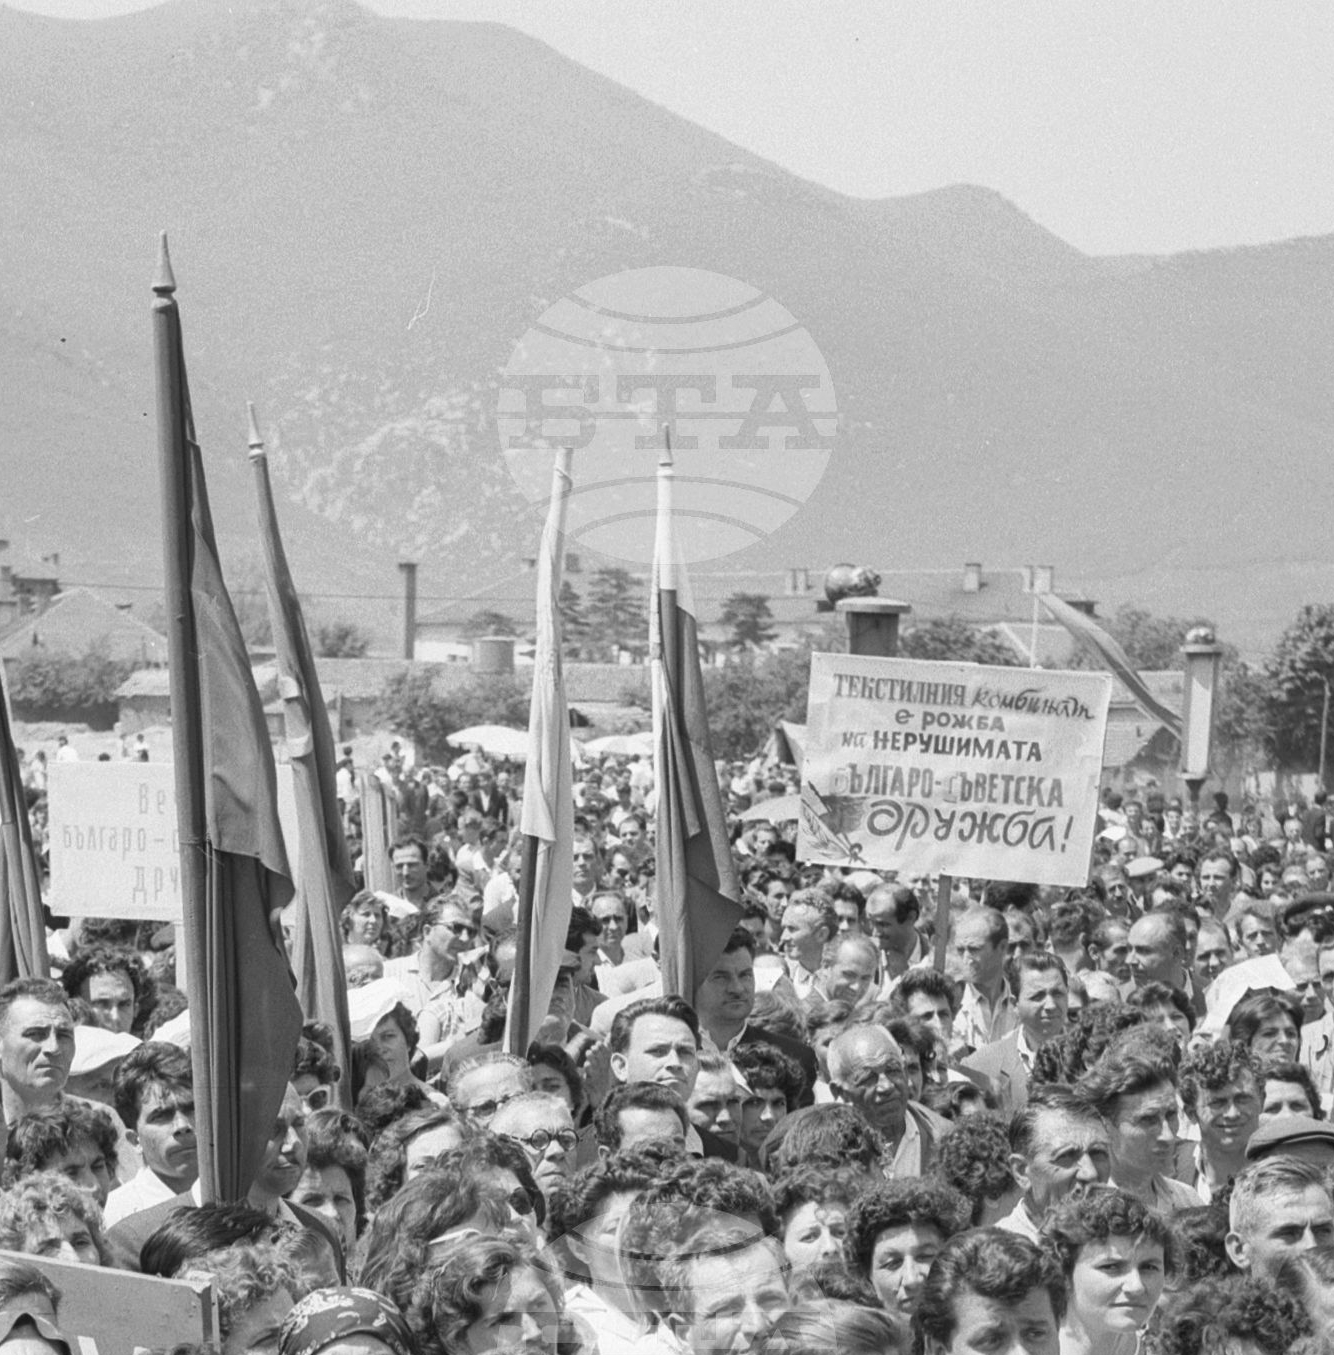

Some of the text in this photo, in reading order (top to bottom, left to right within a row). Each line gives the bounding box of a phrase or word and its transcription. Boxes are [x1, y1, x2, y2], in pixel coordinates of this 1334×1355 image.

[833, 673, 966, 706] ТЕКСТИЛНИЯ
[921, 710, 1005, 732] РОЖБА
[873, 730, 1042, 762] НЕРУШИМАТА
